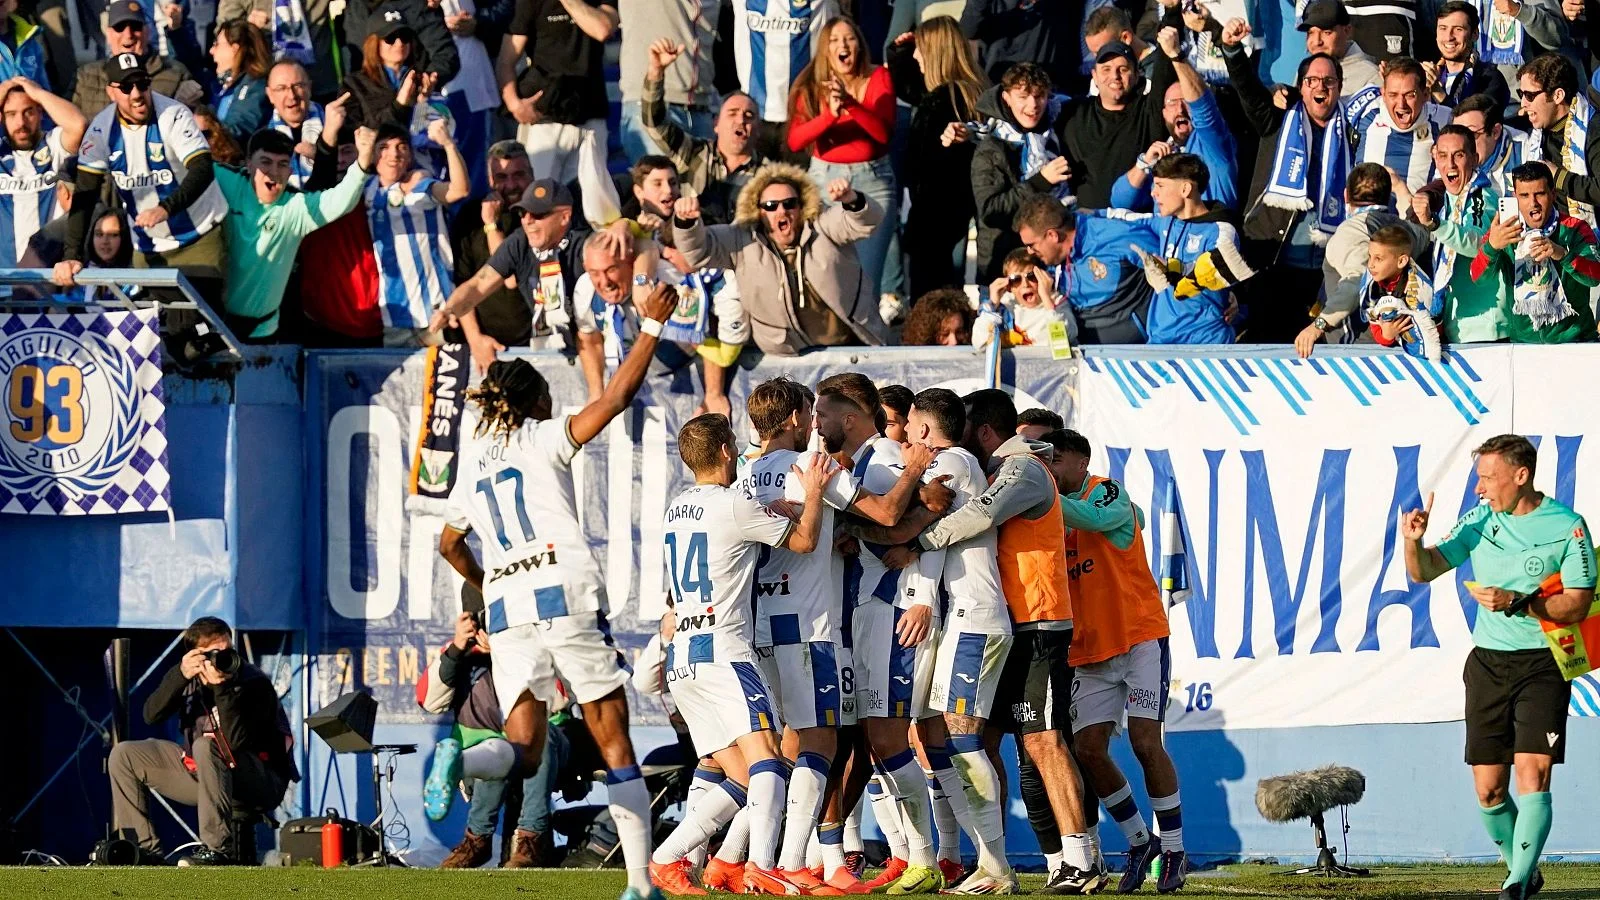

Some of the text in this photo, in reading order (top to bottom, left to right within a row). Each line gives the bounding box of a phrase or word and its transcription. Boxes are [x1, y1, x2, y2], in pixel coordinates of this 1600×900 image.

[0, 335, 97, 377] ORGULLO
[9, 364, 85, 445] 93
[25, 448, 80, 469] 2010
[475, 467, 537, 552] 17
[668, 504, 704, 523] DARKO
[489, 543, 558, 583] zowi
[664, 531, 713, 604] 14
[841, 666, 855, 695] 8
[1185, 682, 1213, 713] 16
[1136, 698, 1159, 711] POKE
